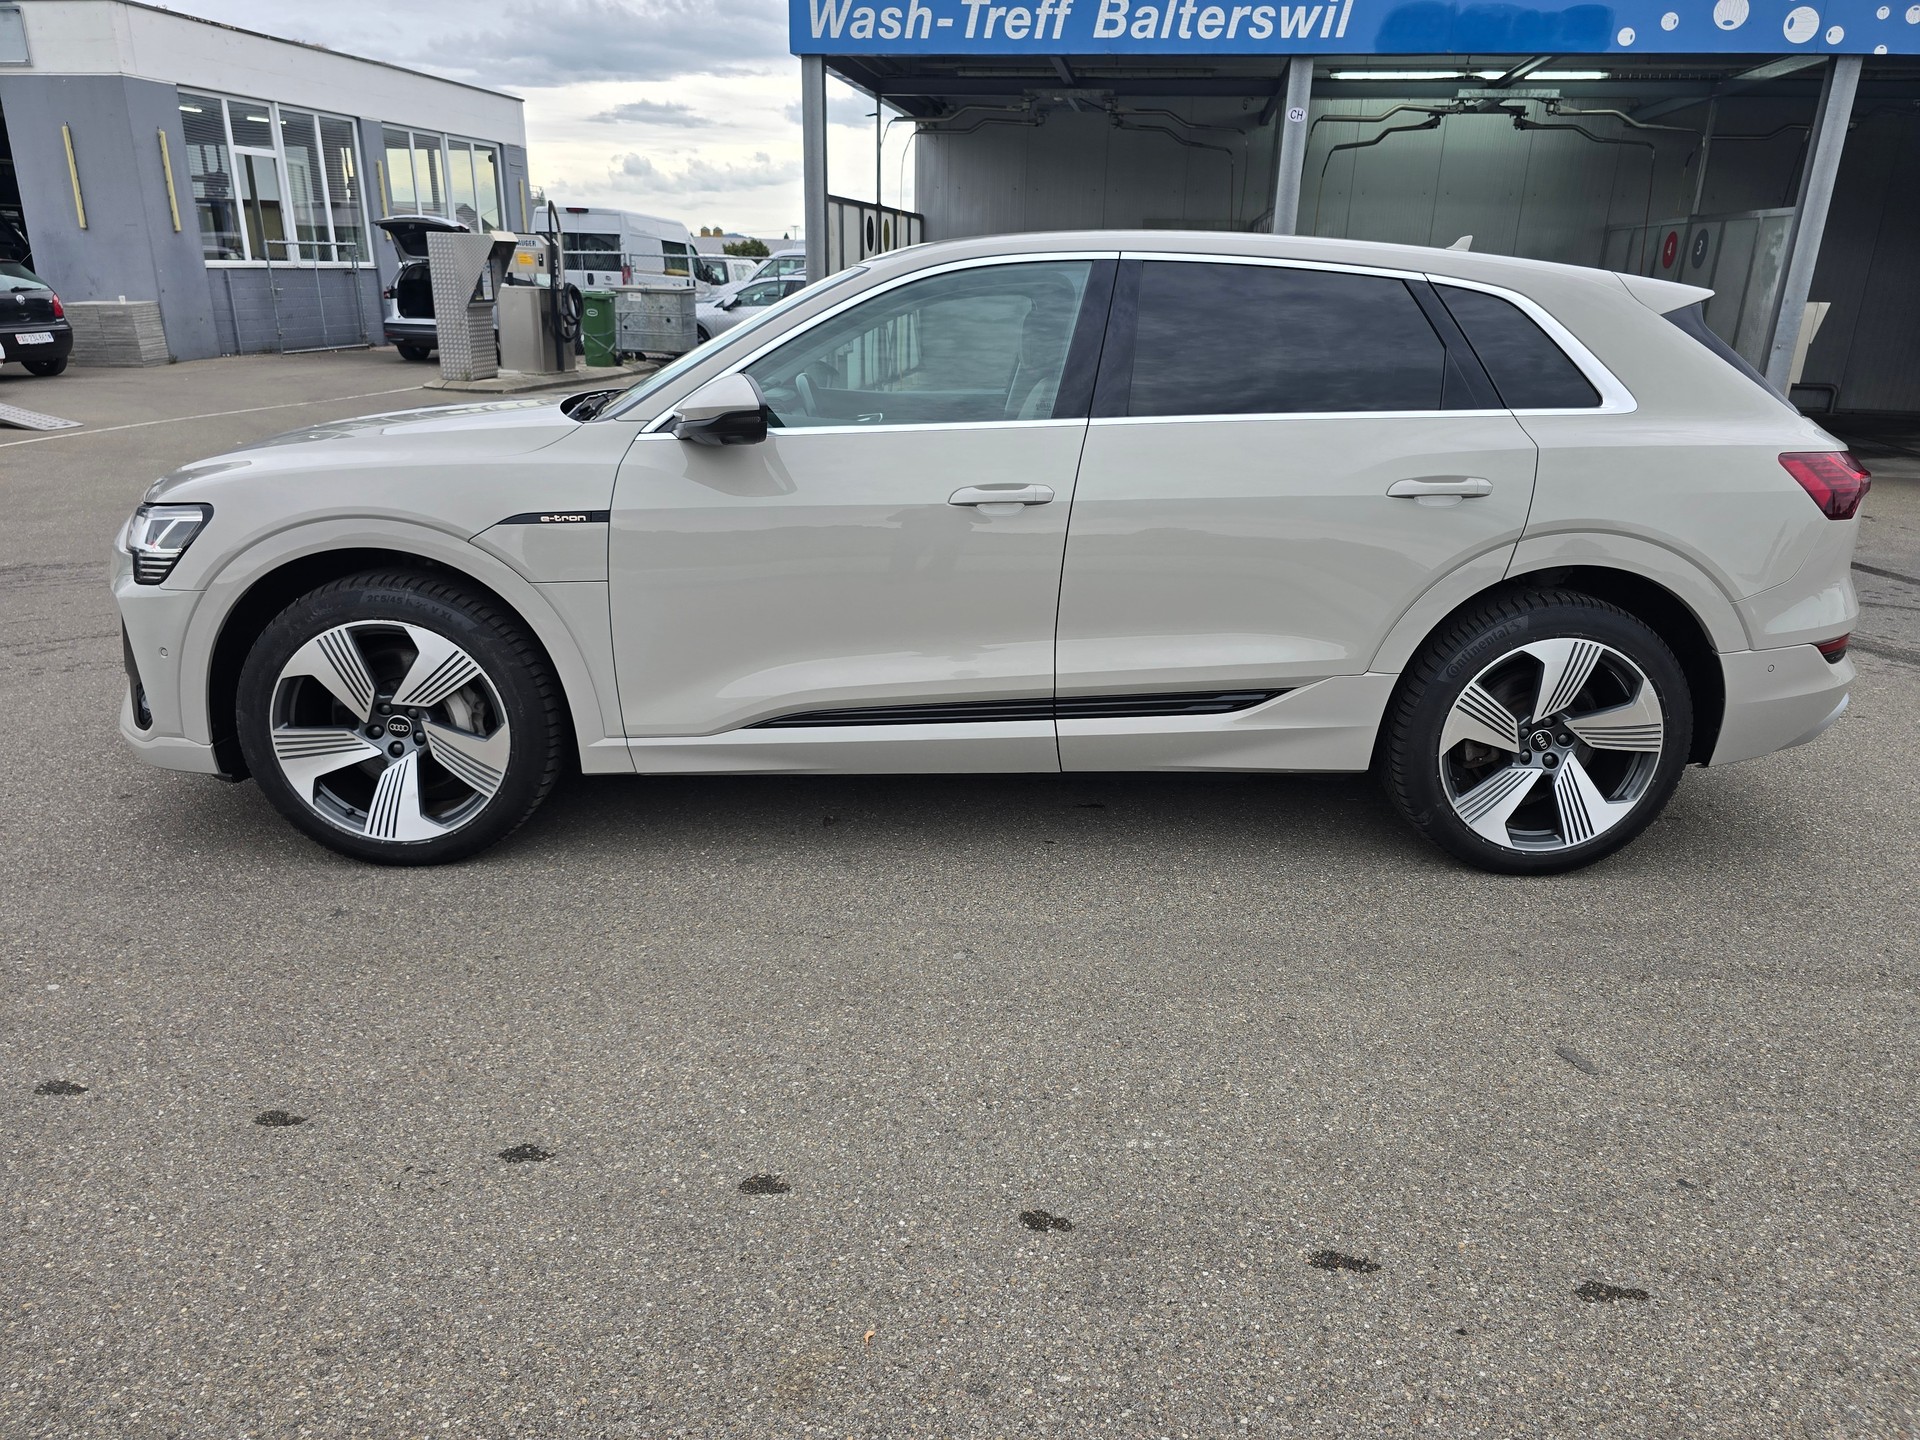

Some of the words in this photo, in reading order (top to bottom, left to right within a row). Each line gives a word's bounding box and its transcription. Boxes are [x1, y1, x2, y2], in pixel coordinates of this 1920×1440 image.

[808, 0, 1073, 39] Wash-Treff
[1093, 0, 1353, 39] Balterswil
[1290, 109, 1304, 121] CH
[1668, 242, 1672, 256] 4
[1697, 240, 1703, 255] 3
[540, 514, 587, 522] e-tron
[1445, 623, 1512, 679] Continental
